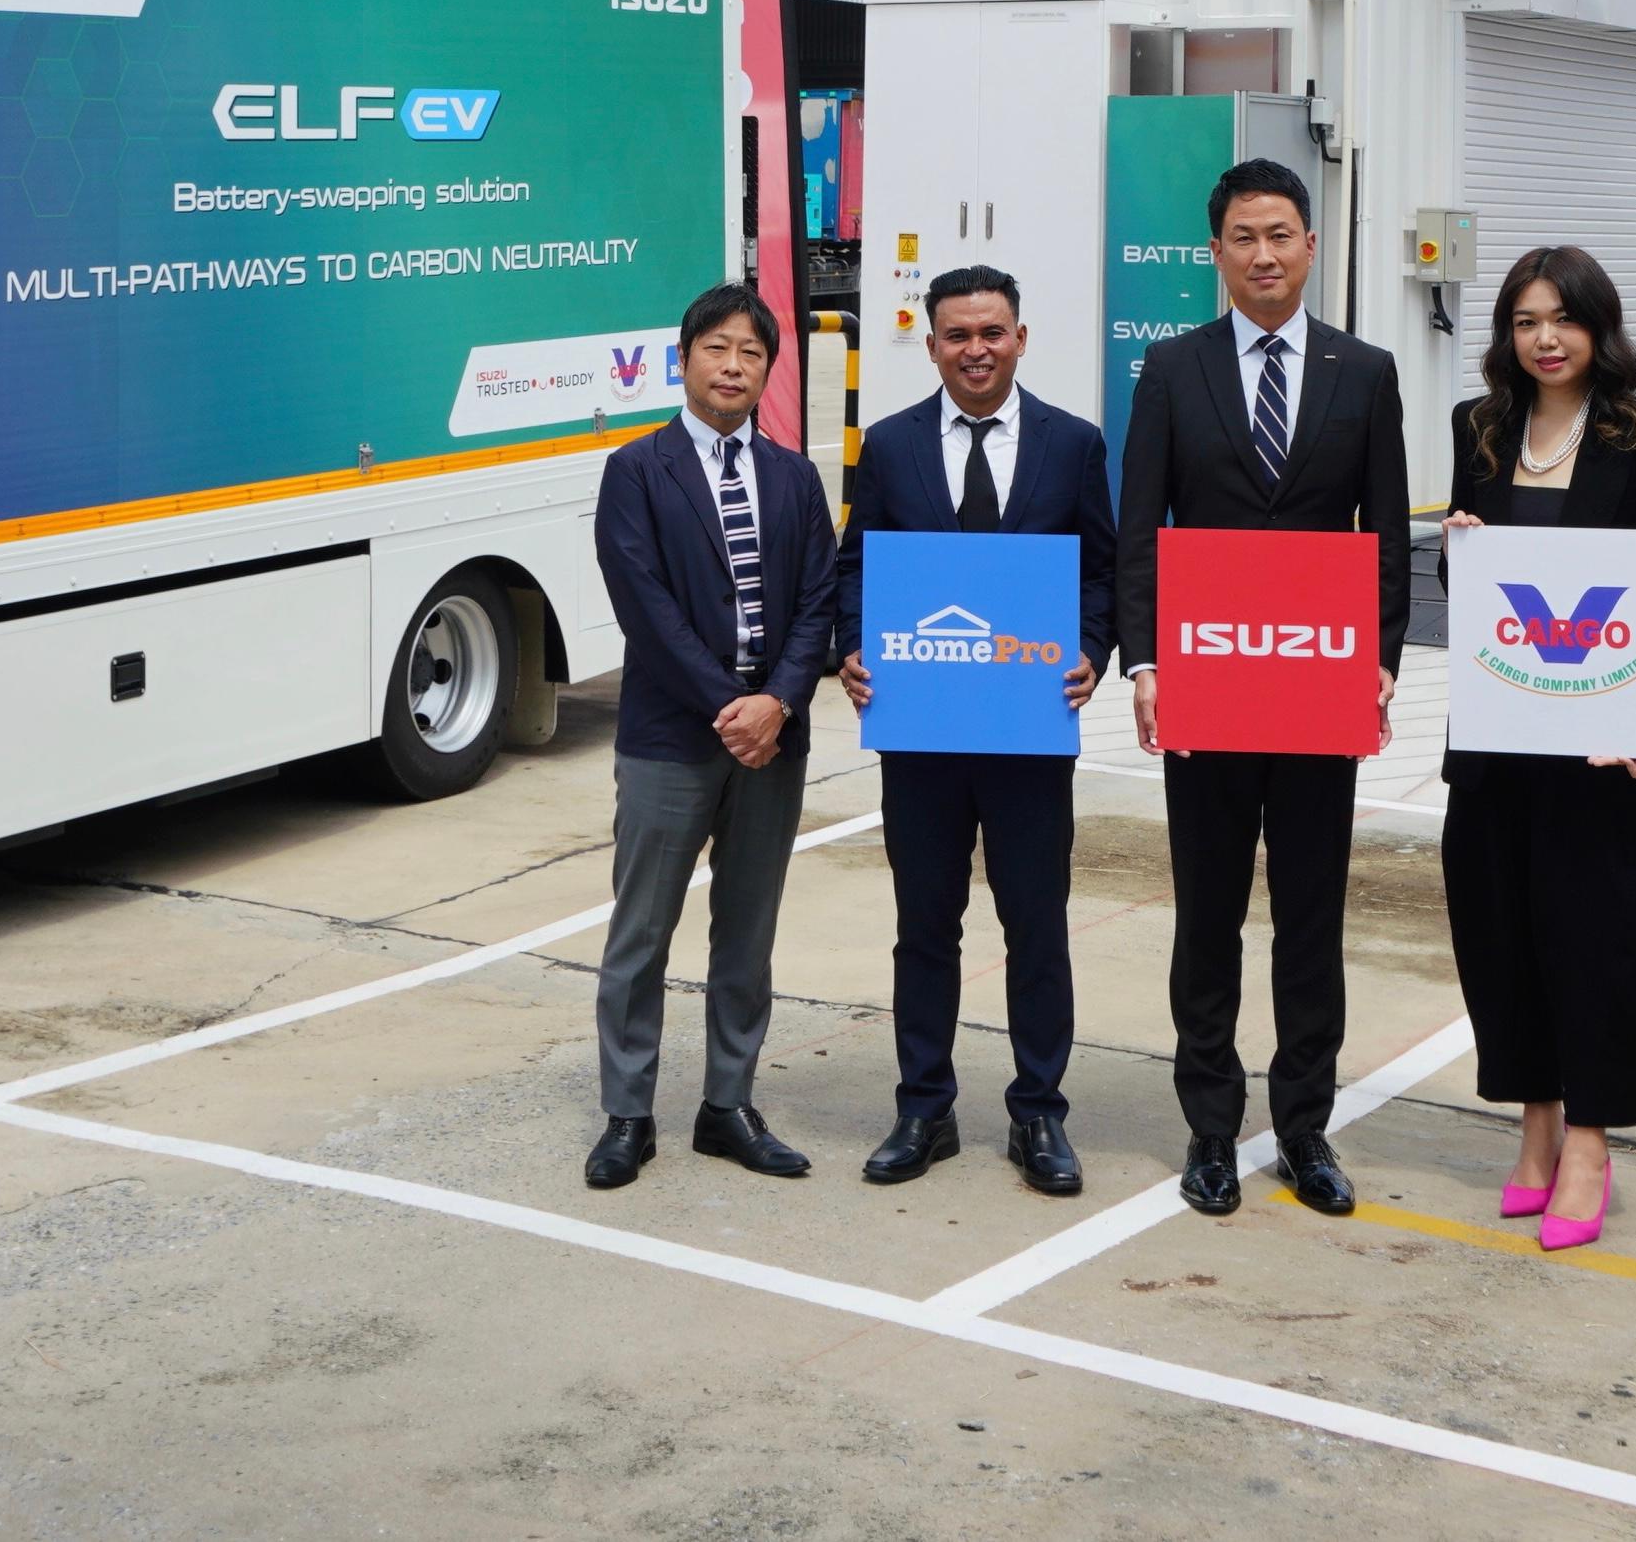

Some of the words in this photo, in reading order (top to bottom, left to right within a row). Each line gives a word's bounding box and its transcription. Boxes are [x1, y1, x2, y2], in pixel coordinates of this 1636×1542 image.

[212, 84, 395, 140] ELF
[411, 97, 487, 133] EV
[173, 178, 426, 216] Battery-swapping
[435, 176, 531, 205] solution
[6, 256, 307, 303] MULTI-PATHWAYS
[317, 253, 357, 282] TO
[368, 247, 482, 280] CARBON
[492, 238, 639, 273] NEUTRALITY
[1123, 245, 1215, 265] BATTE
[1113, 321, 1203, 340] SWAP
[476, 369, 508, 382] ISUZU
[611, 345, 645, 387] V
[477, 380, 530, 398] TRUSTED
[556, 371, 595, 388] BUDDY
[1495, 583, 1630, 665] V
[1496, 617, 1631, 649] CARGO
[881, 632, 1062, 664] HomePro
[1180, 622, 1356, 659] ISUZU
[1533, 676, 1596, 692] COMPANY
